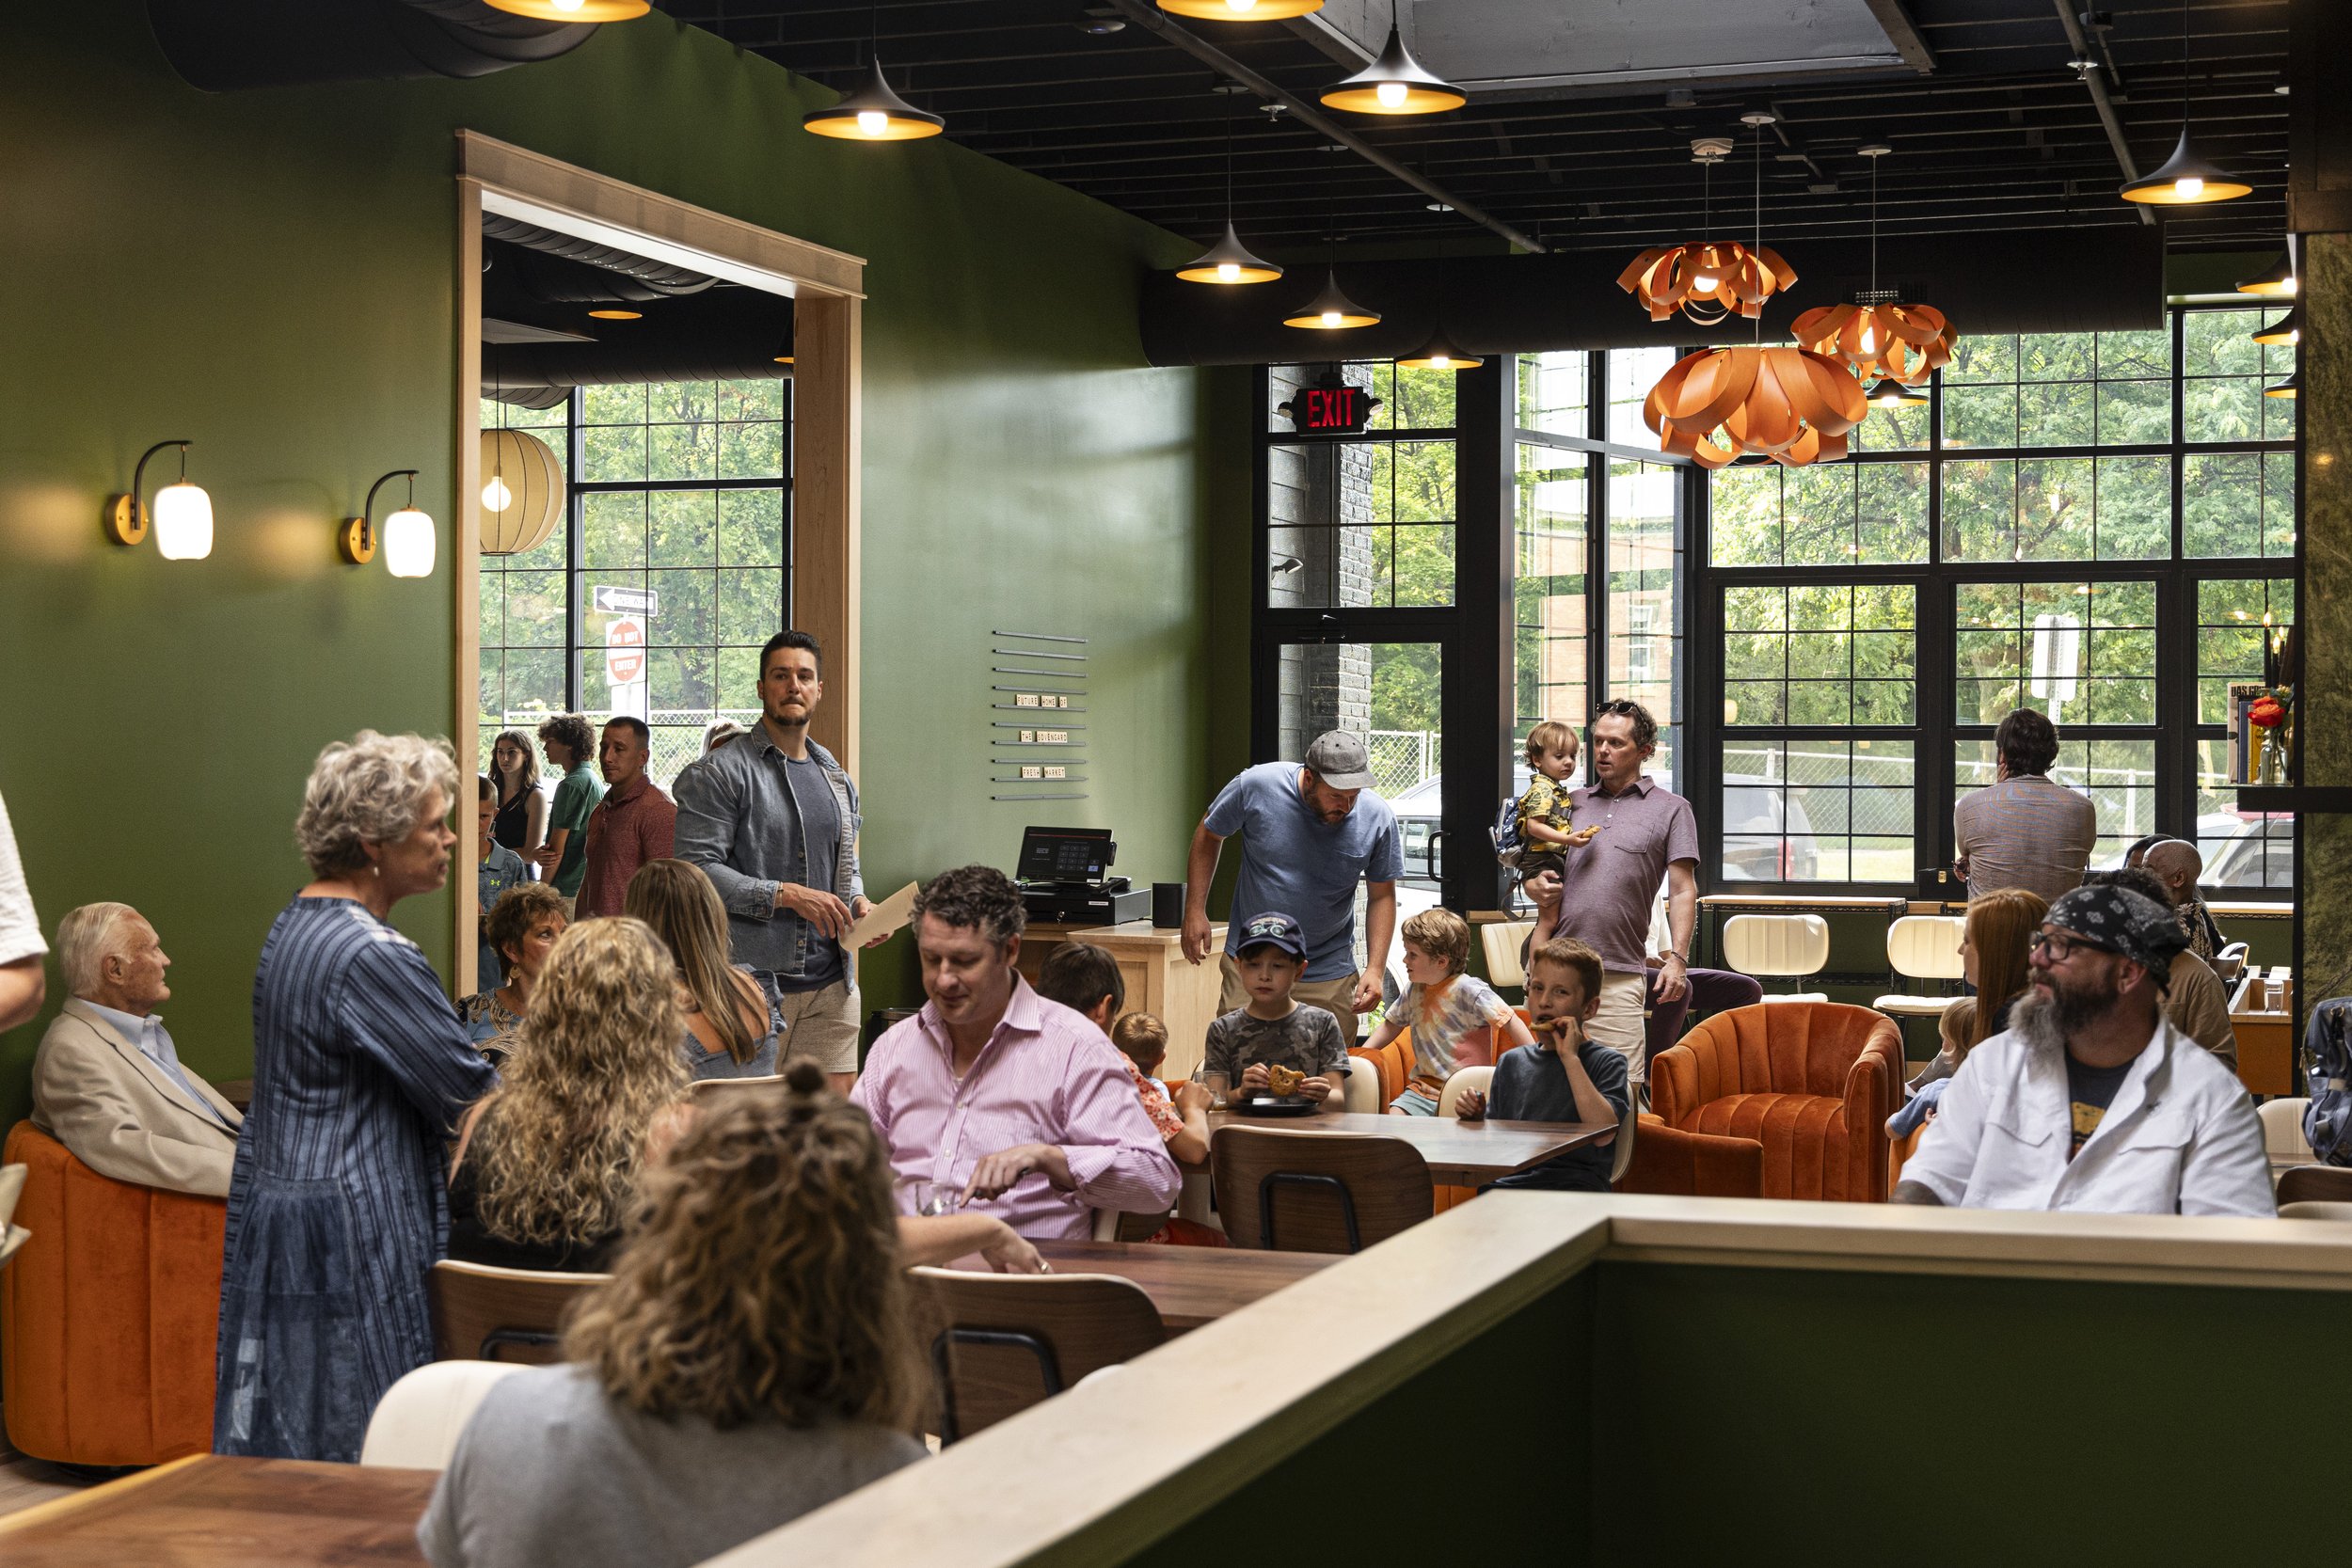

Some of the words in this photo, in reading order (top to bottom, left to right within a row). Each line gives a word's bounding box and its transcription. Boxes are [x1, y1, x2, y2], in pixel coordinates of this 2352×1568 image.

[1308, 389, 1355, 427] EXIT
[612, 633, 622, 644] DO
[624, 631, 639, 643] NOT
[614, 659, 637, 672] ENTER
[1017, 696, 1038, 705] FUTURE
[1041, 697, 1056, 706] HOME
[1059, 698, 1067, 706] OF
[1022, 732, 1032, 741] THE
[1038, 733, 1067, 742] SOVENGARD
[1023, 768, 1040, 777] FRESH
[1044, 768, 1065, 777] MARKET
